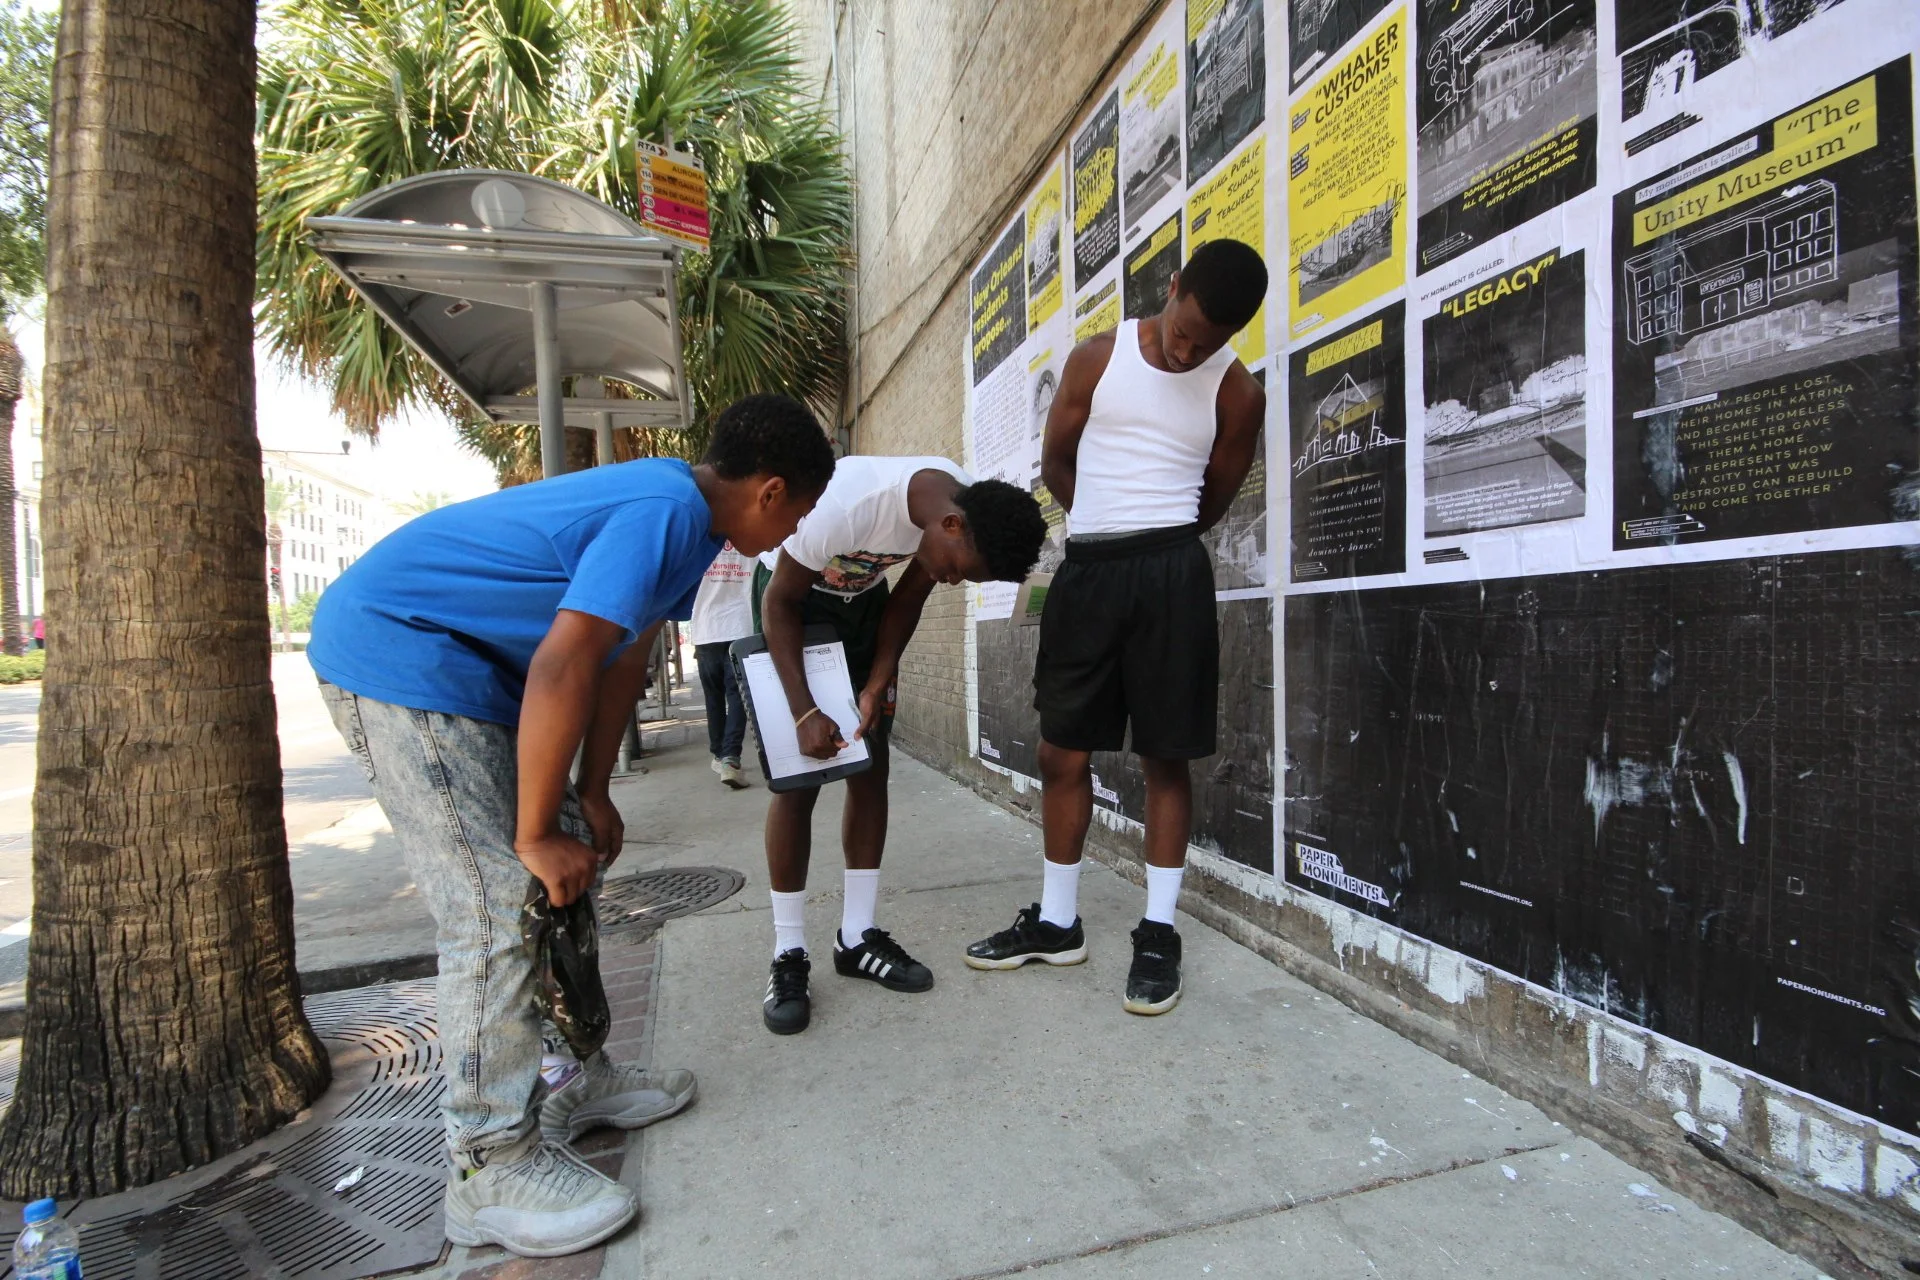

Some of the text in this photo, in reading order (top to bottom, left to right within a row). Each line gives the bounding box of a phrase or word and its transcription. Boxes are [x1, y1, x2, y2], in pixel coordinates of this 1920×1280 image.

[1315, 22, 1399, 99] "WHALER
[1315, 42, 1398, 124] CUSTOMS"
[1345, 75, 1399, 124] WAS AN OWNER
[638, 141, 656, 152] RTA
[1230, 145, 1260, 178] PUBLIC
[1360, 142, 1375, 159] AREA
[1376, 132, 1390, 146] AND
[1495, 160, 1522, 180] LITTLE
[1561, 128, 1579, 143] AND
[672, 166, 703, 181] AURORA
[1227, 166, 1259, 197] SCHOOL
[1346, 167, 1355, 179] AT
[1356, 157, 1371, 171] RISK
[1462, 139, 1580, 211] ALL OF THEM RECORDED THERE
[1638, 141, 1753, 200] My monument is called:
[1486, 194, 1506, 208] WITH
[1645, 196, 1709, 232] Unity
[974, 242, 1024, 315] New Orleans
[1420, 257, 1505, 301] MY MONUMENT IS CALLED:
[973, 285, 1009, 336] residents
[973, 315, 1012, 363] propose...
[1675, 416, 1710, 429] THEIR
[1715, 405, 1761, 421] HOMES
[1768, 399, 1782, 410] IN
[1790, 383, 1854, 405] KATRINA
[1736, 386, 1787, 404] PEOPLE
[1795, 374, 1832, 390] LOST
[1676, 400, 1845, 442] AND BECAME HOMELESS
[1691, 416, 1831, 450] THIS SHELTER GAVE
[1688, 442, 1833, 476] IT REPRESENTS HOW
[1709, 434, 1804, 459] THEM A HOME
[1346, 486, 1359, 495] old
[1361, 480, 1381, 492] black
[1553, 481, 1574, 489] figure
[1673, 466, 1853, 501] DESTROYED CAN REBUILD
[1700, 458, 1819, 486] A CITY THAT WAS
[1364, 496, 1382, 505] HERE
[1681, 484, 1832, 512] AND COME TOGETHER
[1308, 544, 1345, 557] domino's
[1300, 845, 1334, 869] PAPER
[1303, 861, 1380, 901] MONUMENTS
[1777, 976, 1886, 1016] PAPERMONUMENTS.ORG
